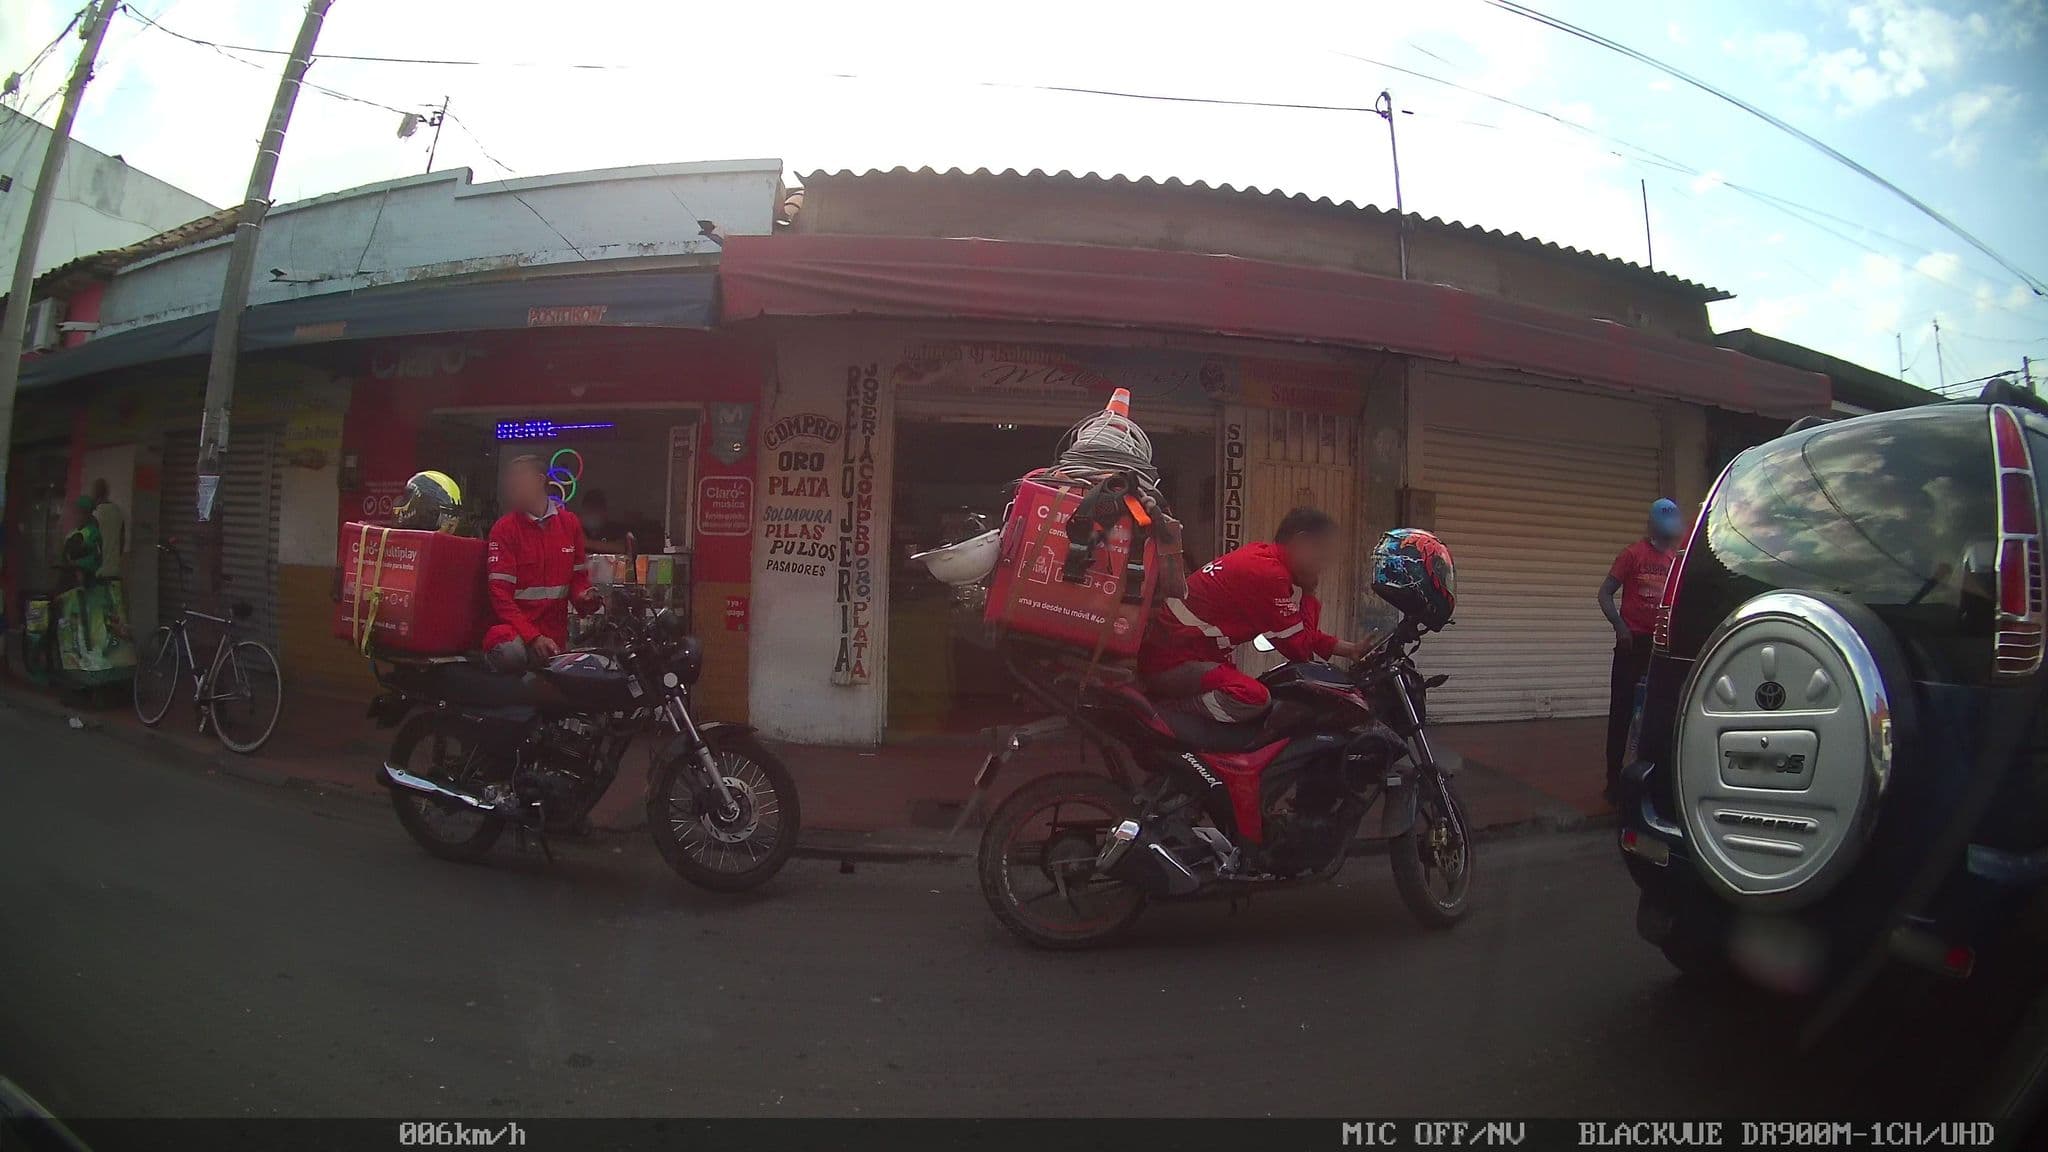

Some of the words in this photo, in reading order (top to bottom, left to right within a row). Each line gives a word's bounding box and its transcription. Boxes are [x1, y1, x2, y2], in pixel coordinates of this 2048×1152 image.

[766, 416, 840, 448] COMPRO
[778, 451, 825, 472] ORO
[706, 484, 743, 499] Claro
[768, 475, 831, 498] PLATA
[1225, 423, 1244, 555] SOLDADUR
[763, 505, 833, 524] SOLDADURA
[854, 463, 874, 557] COMPRO
[765, 523, 826, 541] PILAS
[384, 545, 417, 562] ultiplay
[769, 540, 837, 562] PULSOS
[766, 559, 827, 577] PASADORES
[850, 601, 869, 679] PLATA
